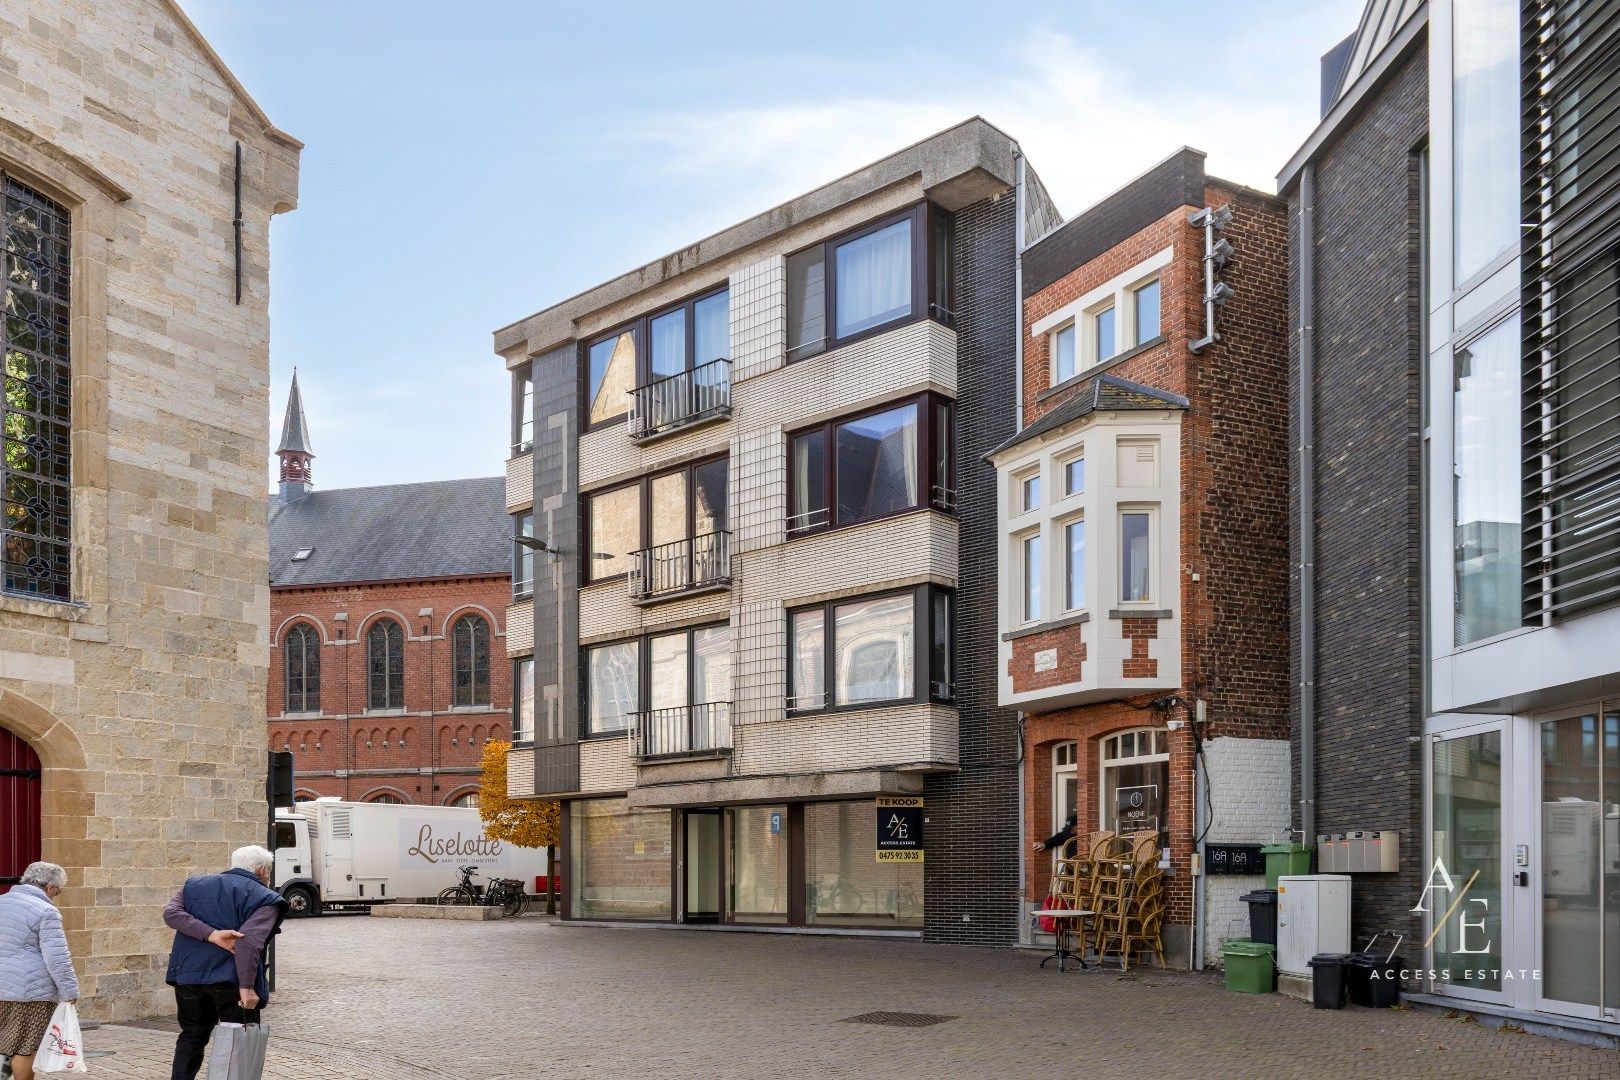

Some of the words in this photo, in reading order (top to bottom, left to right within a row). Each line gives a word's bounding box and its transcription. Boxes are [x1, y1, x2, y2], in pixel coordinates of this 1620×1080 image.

[879, 798, 891, 806] TE
[892, 798, 919, 806] KOOP
[408, 824, 503, 864] Liselotte
[879, 851, 895, 860] 0475
[895, 851, 903, 860] 92
[903, 851, 911, 860] 30
[911, 851, 919, 860] 35
[1211, 850, 1227, 861] 16A
[1231, 852, 1247, 863] 16A
